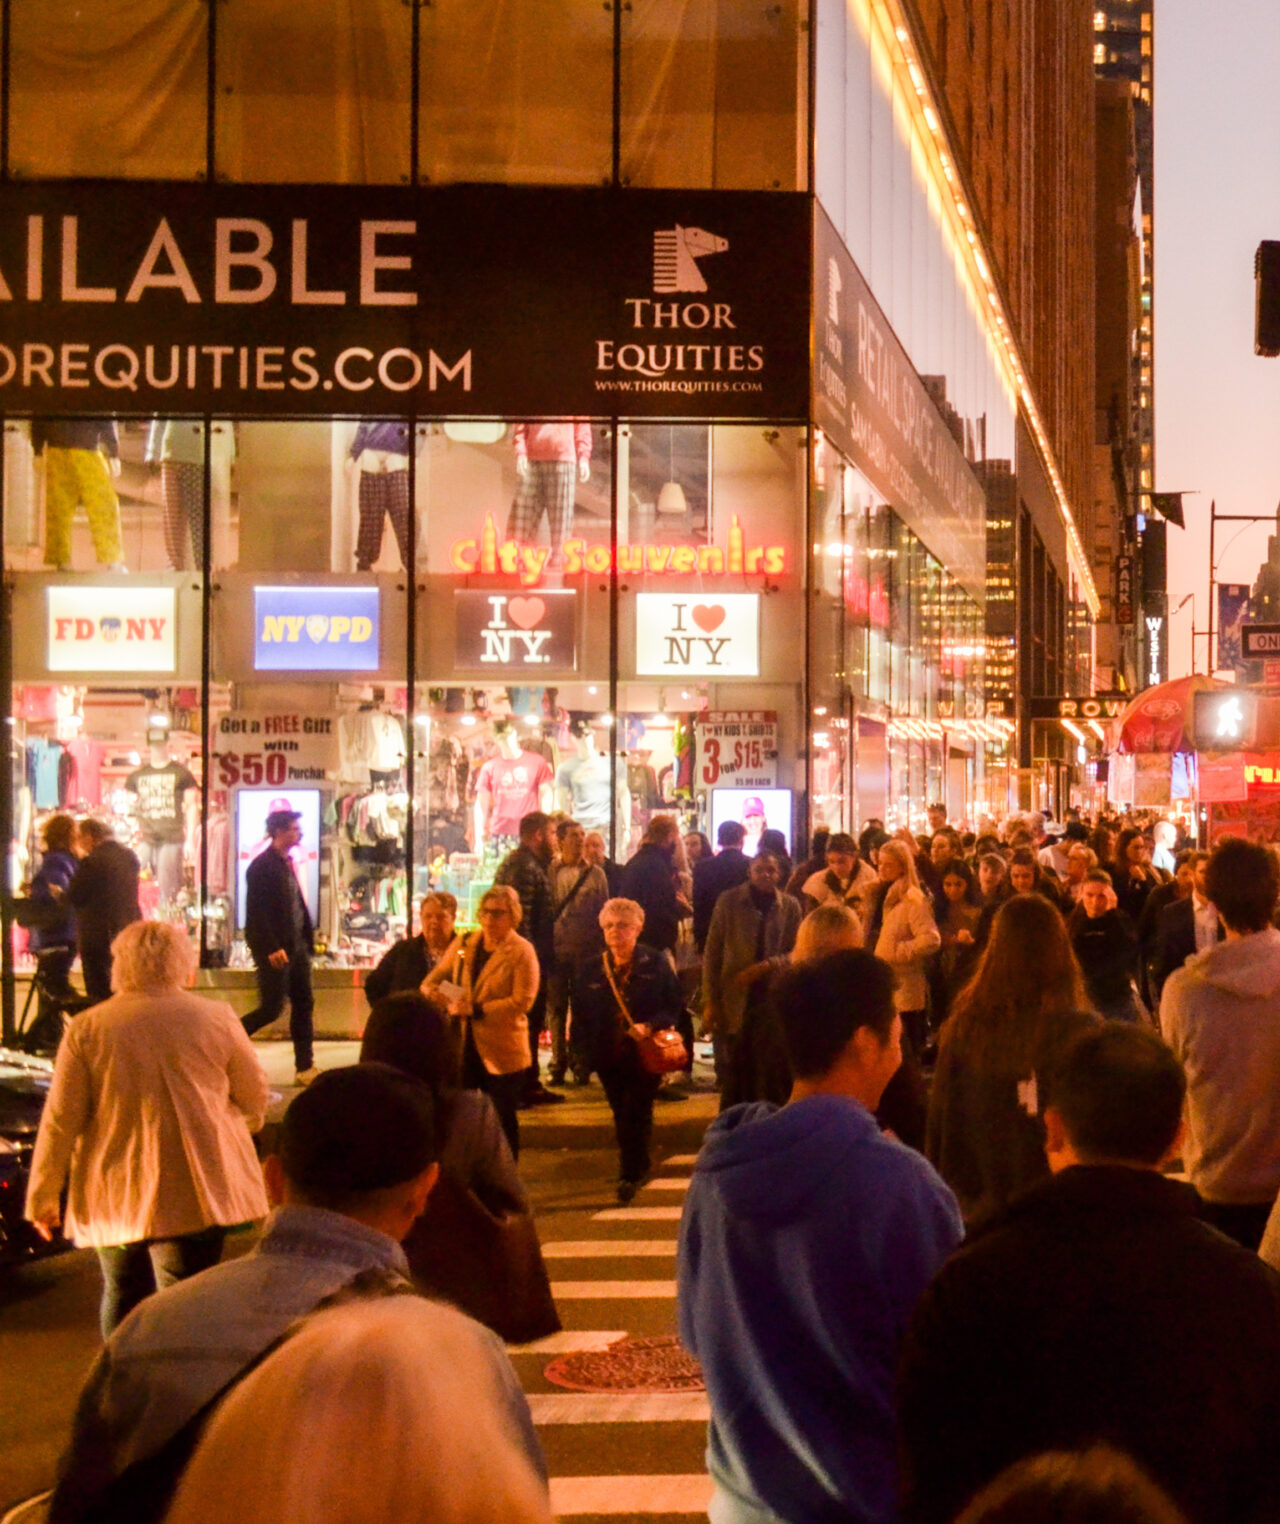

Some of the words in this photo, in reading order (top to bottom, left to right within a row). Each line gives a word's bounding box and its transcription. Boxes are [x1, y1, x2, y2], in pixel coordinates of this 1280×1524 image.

[625, 298, 736, 329] THOR
[595, 340, 764, 377] EQUITIES
[595, 380, 763, 394] WWW.THOREQUITIES.COM
[1119, 557, 1130, 604] PARK
[487, 596, 507, 629] I
[671, 603, 687, 631] I
[1146, 617, 1162, 685] WESTIN
[708, 711, 765, 722] SALE
[1059, 700, 1128, 717] ROW
[220, 717, 246, 734] Get
[250, 721, 260, 733] a
[264, 715, 300, 734] FREE
[303, 717, 331, 734] Gift
[724, 724, 740, 736] KIDS
[749, 724, 774, 736] SHIRTS
[264, 741, 299, 751] with
[219, 751, 287, 788] $50
[702, 738, 721, 785] 3
